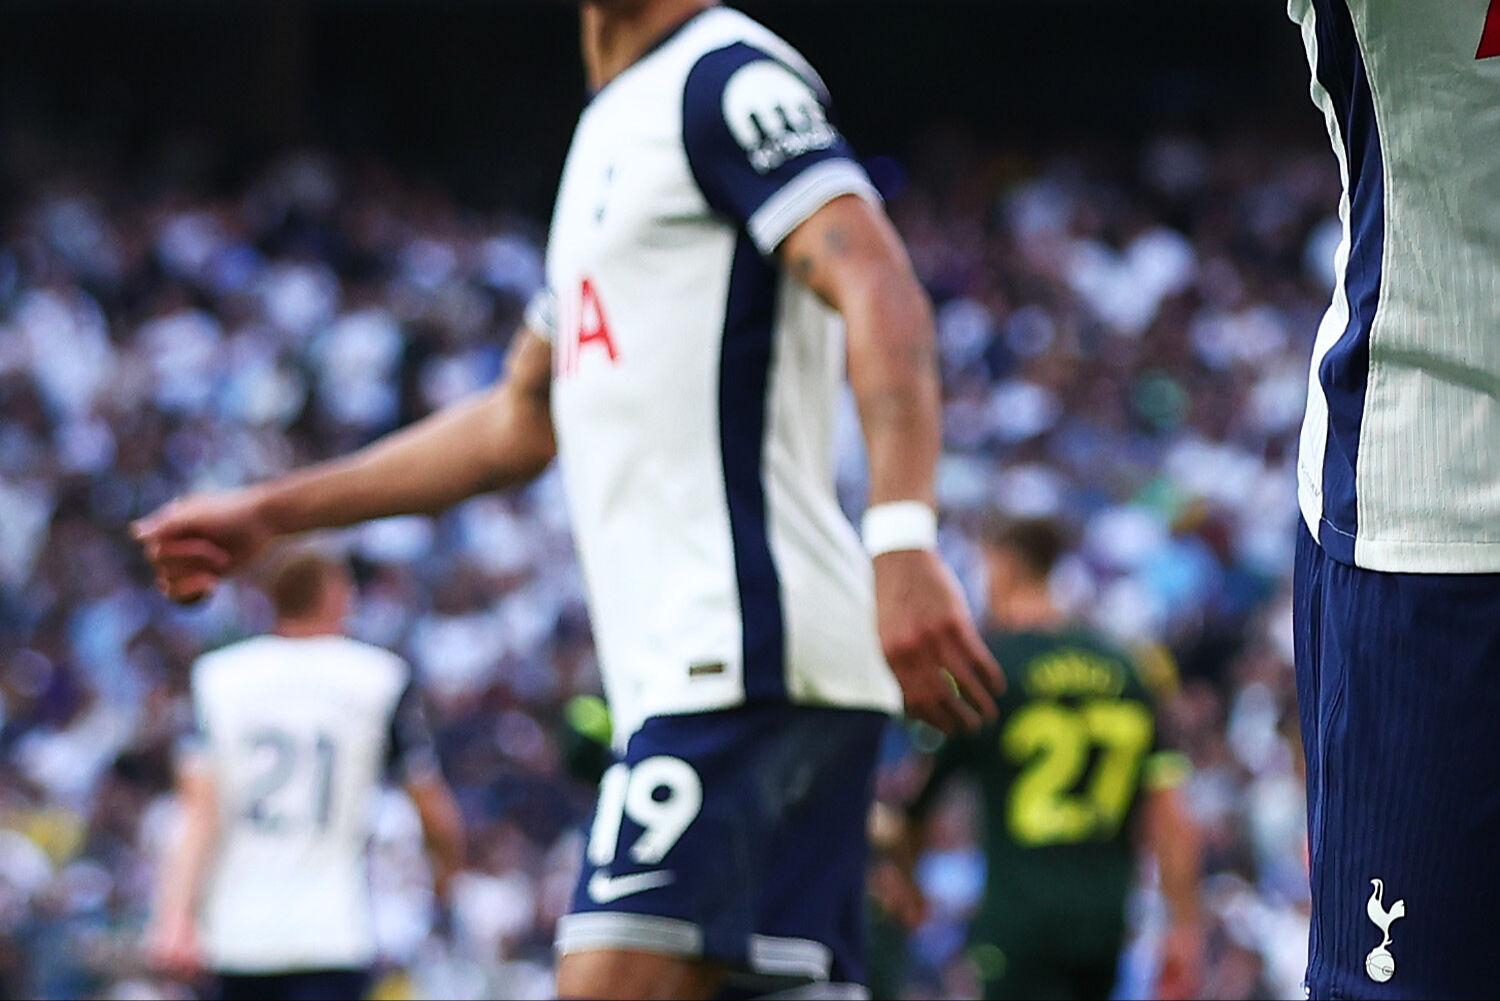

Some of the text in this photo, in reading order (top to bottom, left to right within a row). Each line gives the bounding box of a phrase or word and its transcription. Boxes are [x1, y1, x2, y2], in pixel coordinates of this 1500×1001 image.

[241, 727, 335, 832] 21
[588, 755, 703, 866] 19
[1003, 702, 1153, 845] 27
